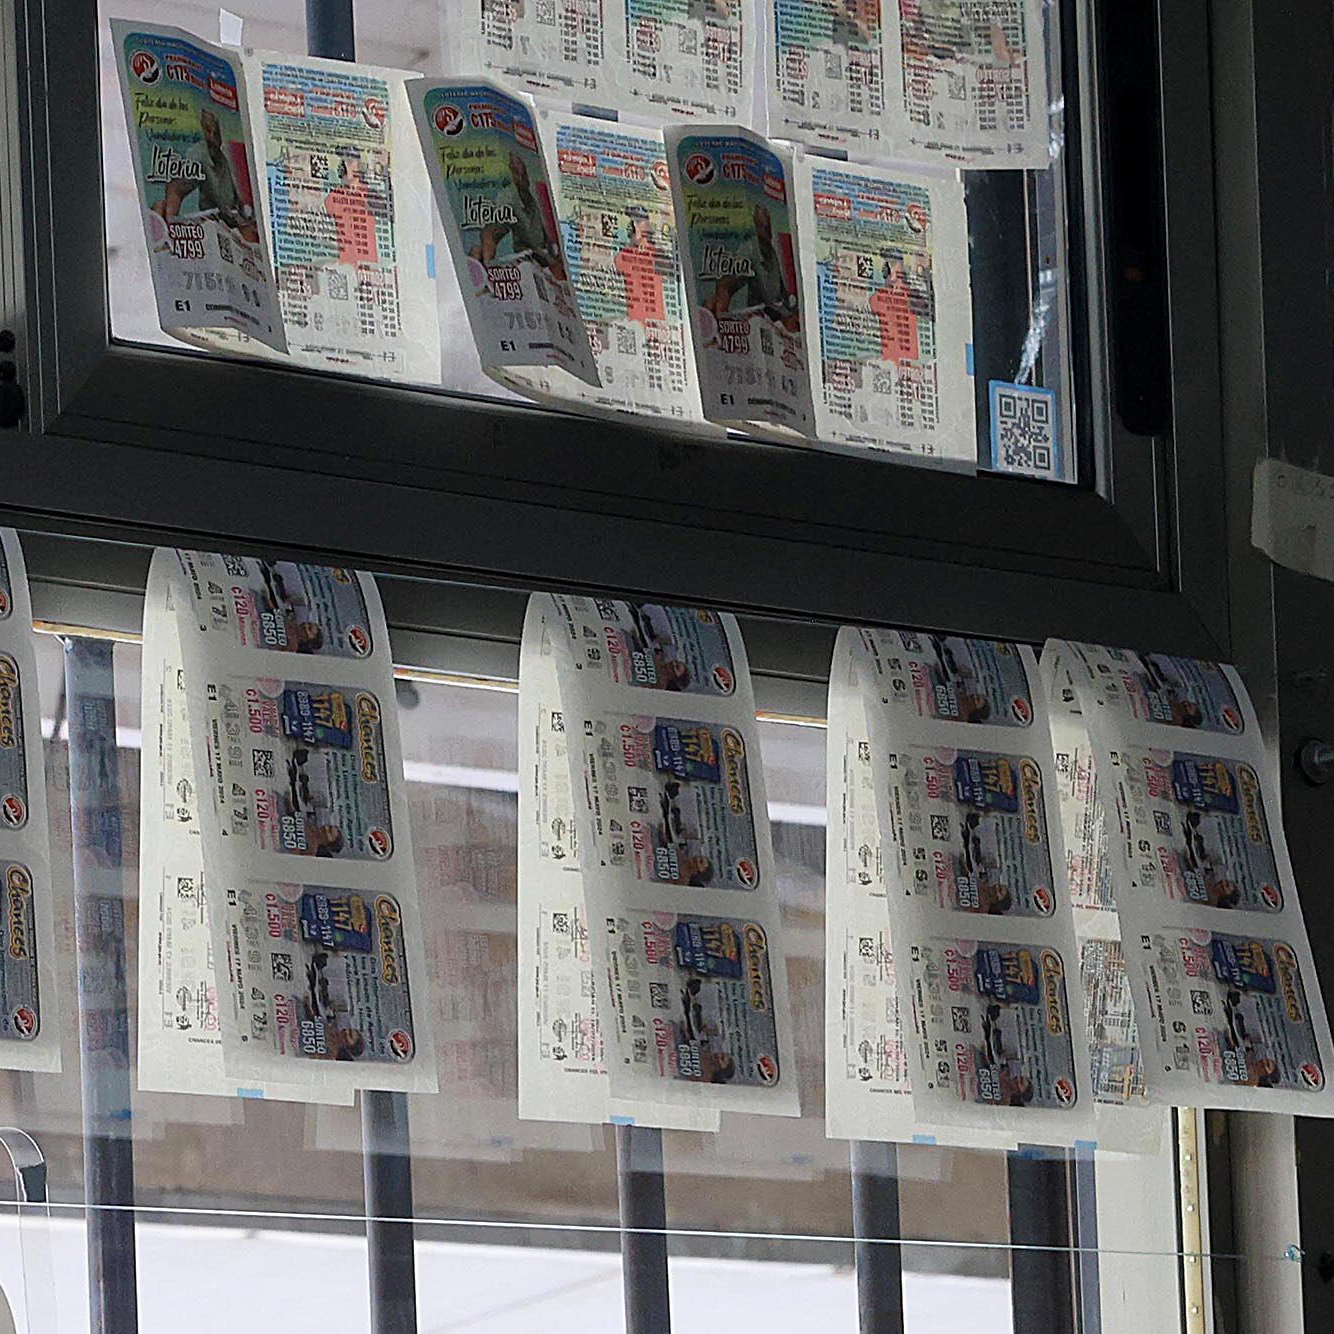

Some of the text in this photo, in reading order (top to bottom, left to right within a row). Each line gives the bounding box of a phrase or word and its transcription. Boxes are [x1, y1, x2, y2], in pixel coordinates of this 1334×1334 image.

[169, 224, 204, 239] SORTEO
[172, 239, 205, 259] 4799
[487, 267, 522, 282] SORTEO
[493, 282, 523, 300] 4799
[174, 300, 192, 312] E1
[718, 320, 751, 336] SORTEO
[500, 340, 517, 352] E1
[721, 335, 750, 355] 4799
[720, 393, 734, 406] E1
[206, 683, 218, 703] E1
[584, 719, 594, 738] E1
[889, 753, 899, 771] E1
[1110, 750, 1121, 768] E1
[280, 815, 299, 850] 6850
[227, 889, 238, 908] E1
[606, 917, 617, 936] E1
[1140, 934, 1152, 951] E1
[910, 945, 920, 963] E1
[300, 1020, 318, 1054] 6850
